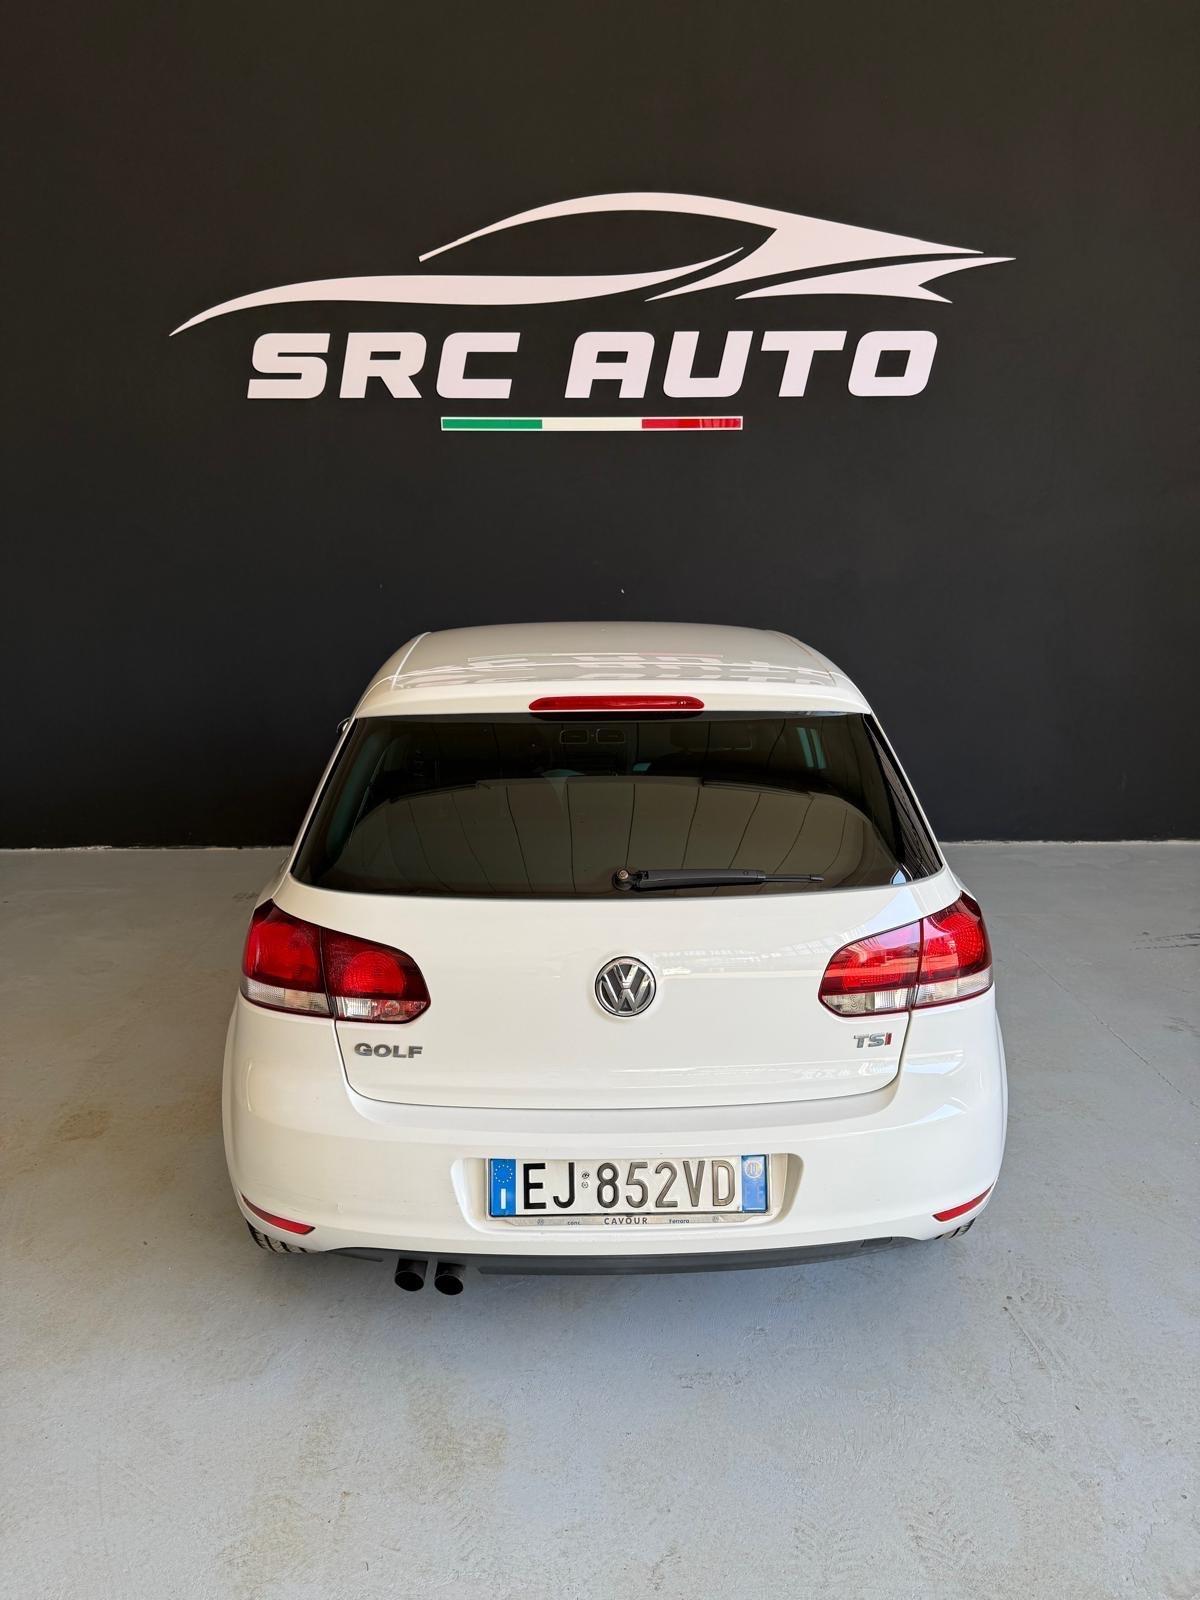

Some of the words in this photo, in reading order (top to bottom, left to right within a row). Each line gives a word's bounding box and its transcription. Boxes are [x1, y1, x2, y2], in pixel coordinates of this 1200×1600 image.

[247, 331, 520, 399] SRC
[564, 330, 938, 399] AUTO
[853, 1032, 892, 1048] TSI
[354, 1042, 423, 1058] GOLF
[603, 1216, 648, 1225] CAVOUR
